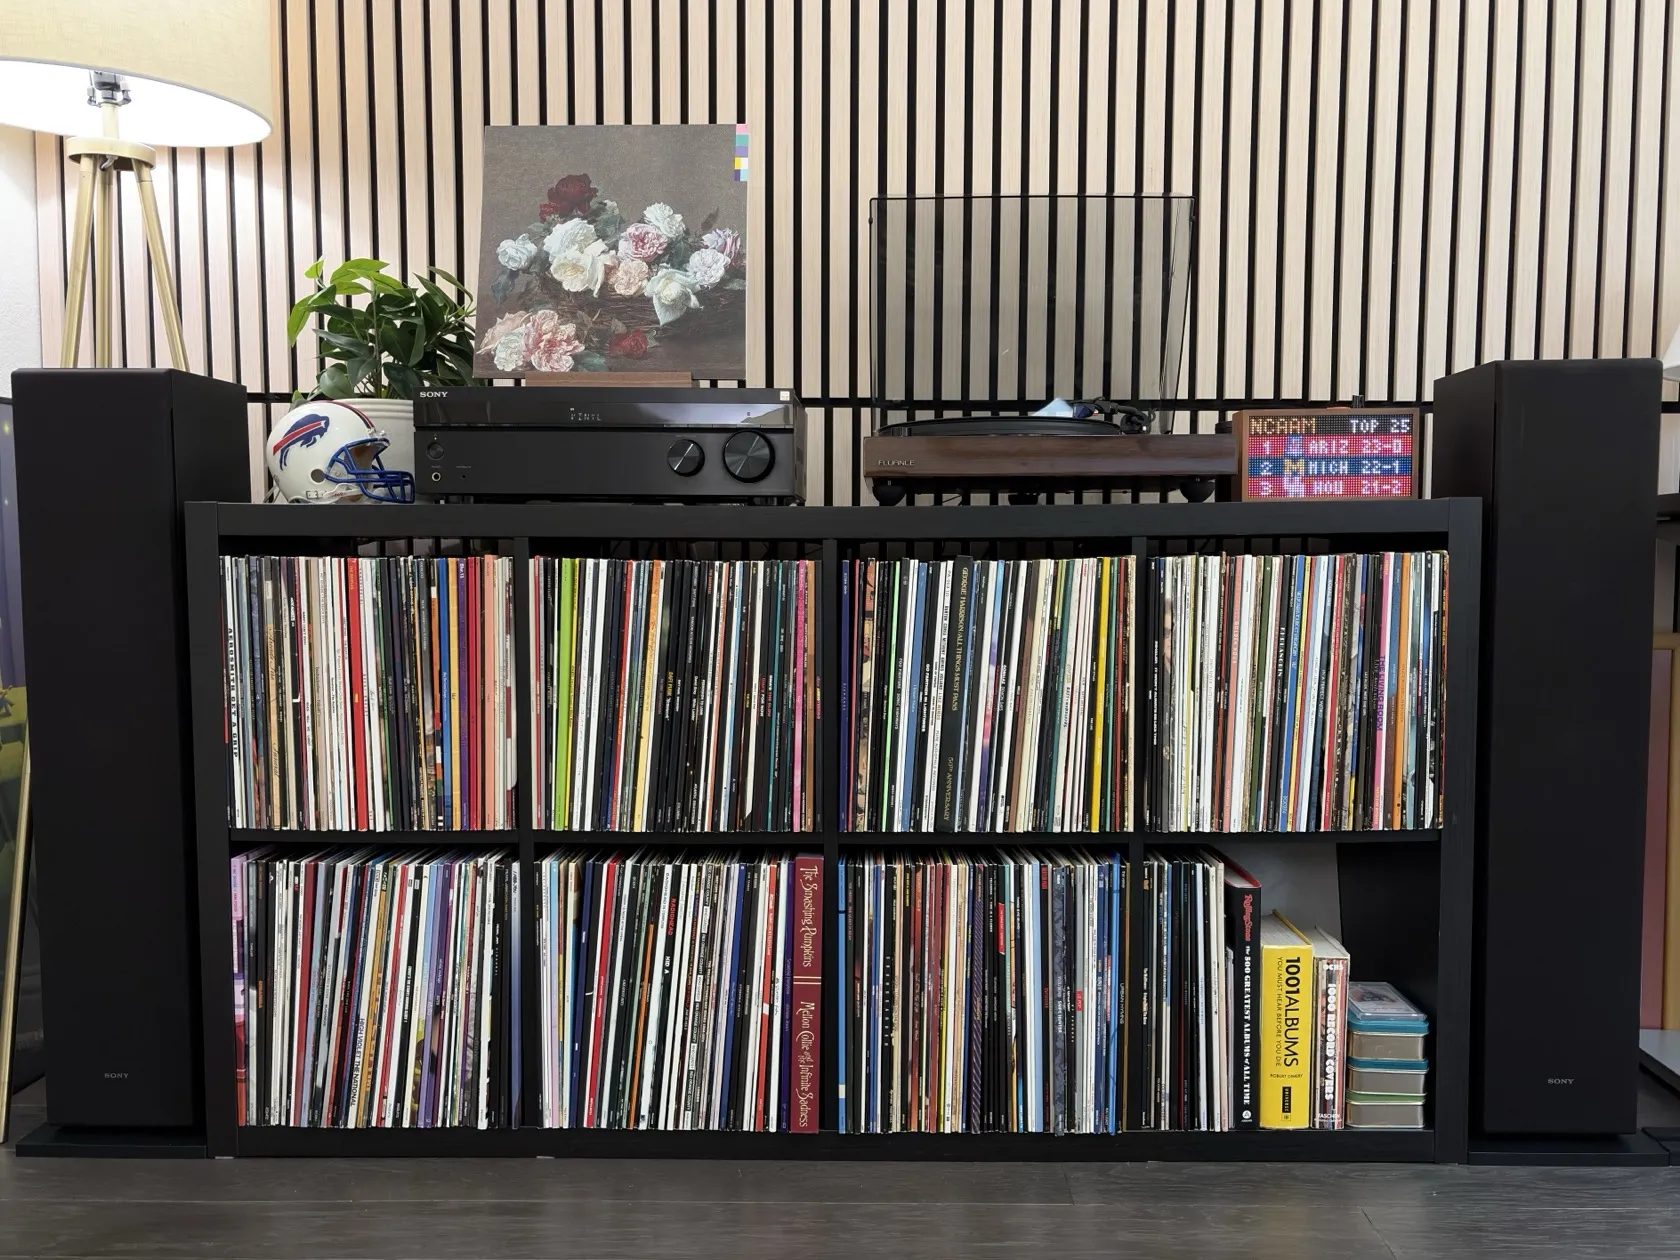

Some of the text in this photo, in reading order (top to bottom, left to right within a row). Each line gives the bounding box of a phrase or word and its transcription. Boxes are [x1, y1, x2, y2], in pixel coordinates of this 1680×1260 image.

[1250, 418, 1410, 434] NCAAM TOP 25
[1262, 441, 1271, 454] 1
[1309, 440, 1349, 454] ARIZ
[1260, 462, 1272, 475] 2
[1309, 461, 1348, 474] MICH
[1362, 460, 1400, 474] 22-1
[1260, 482, 1272, 495] 3
[1362, 480, 1402, 494] 21-2
[800, 866, 818, 880] The
[800, 879, 818, 925] Smashing
[668, 898, 676, 935] RADIOHEAD
[800, 926, 816, 967] Pumpkins
[796, 1001, 814, 1028] Mellon
[796, 1030, 814, 1050] Collie
[1325, 984, 1337, 1100] 1000 RECORD COVERS
[350, 1074, 359, 1106] NATIONAL
[799, 1064, 814, 1090] Infinite
[796, 1088, 813, 1127] Sadness
